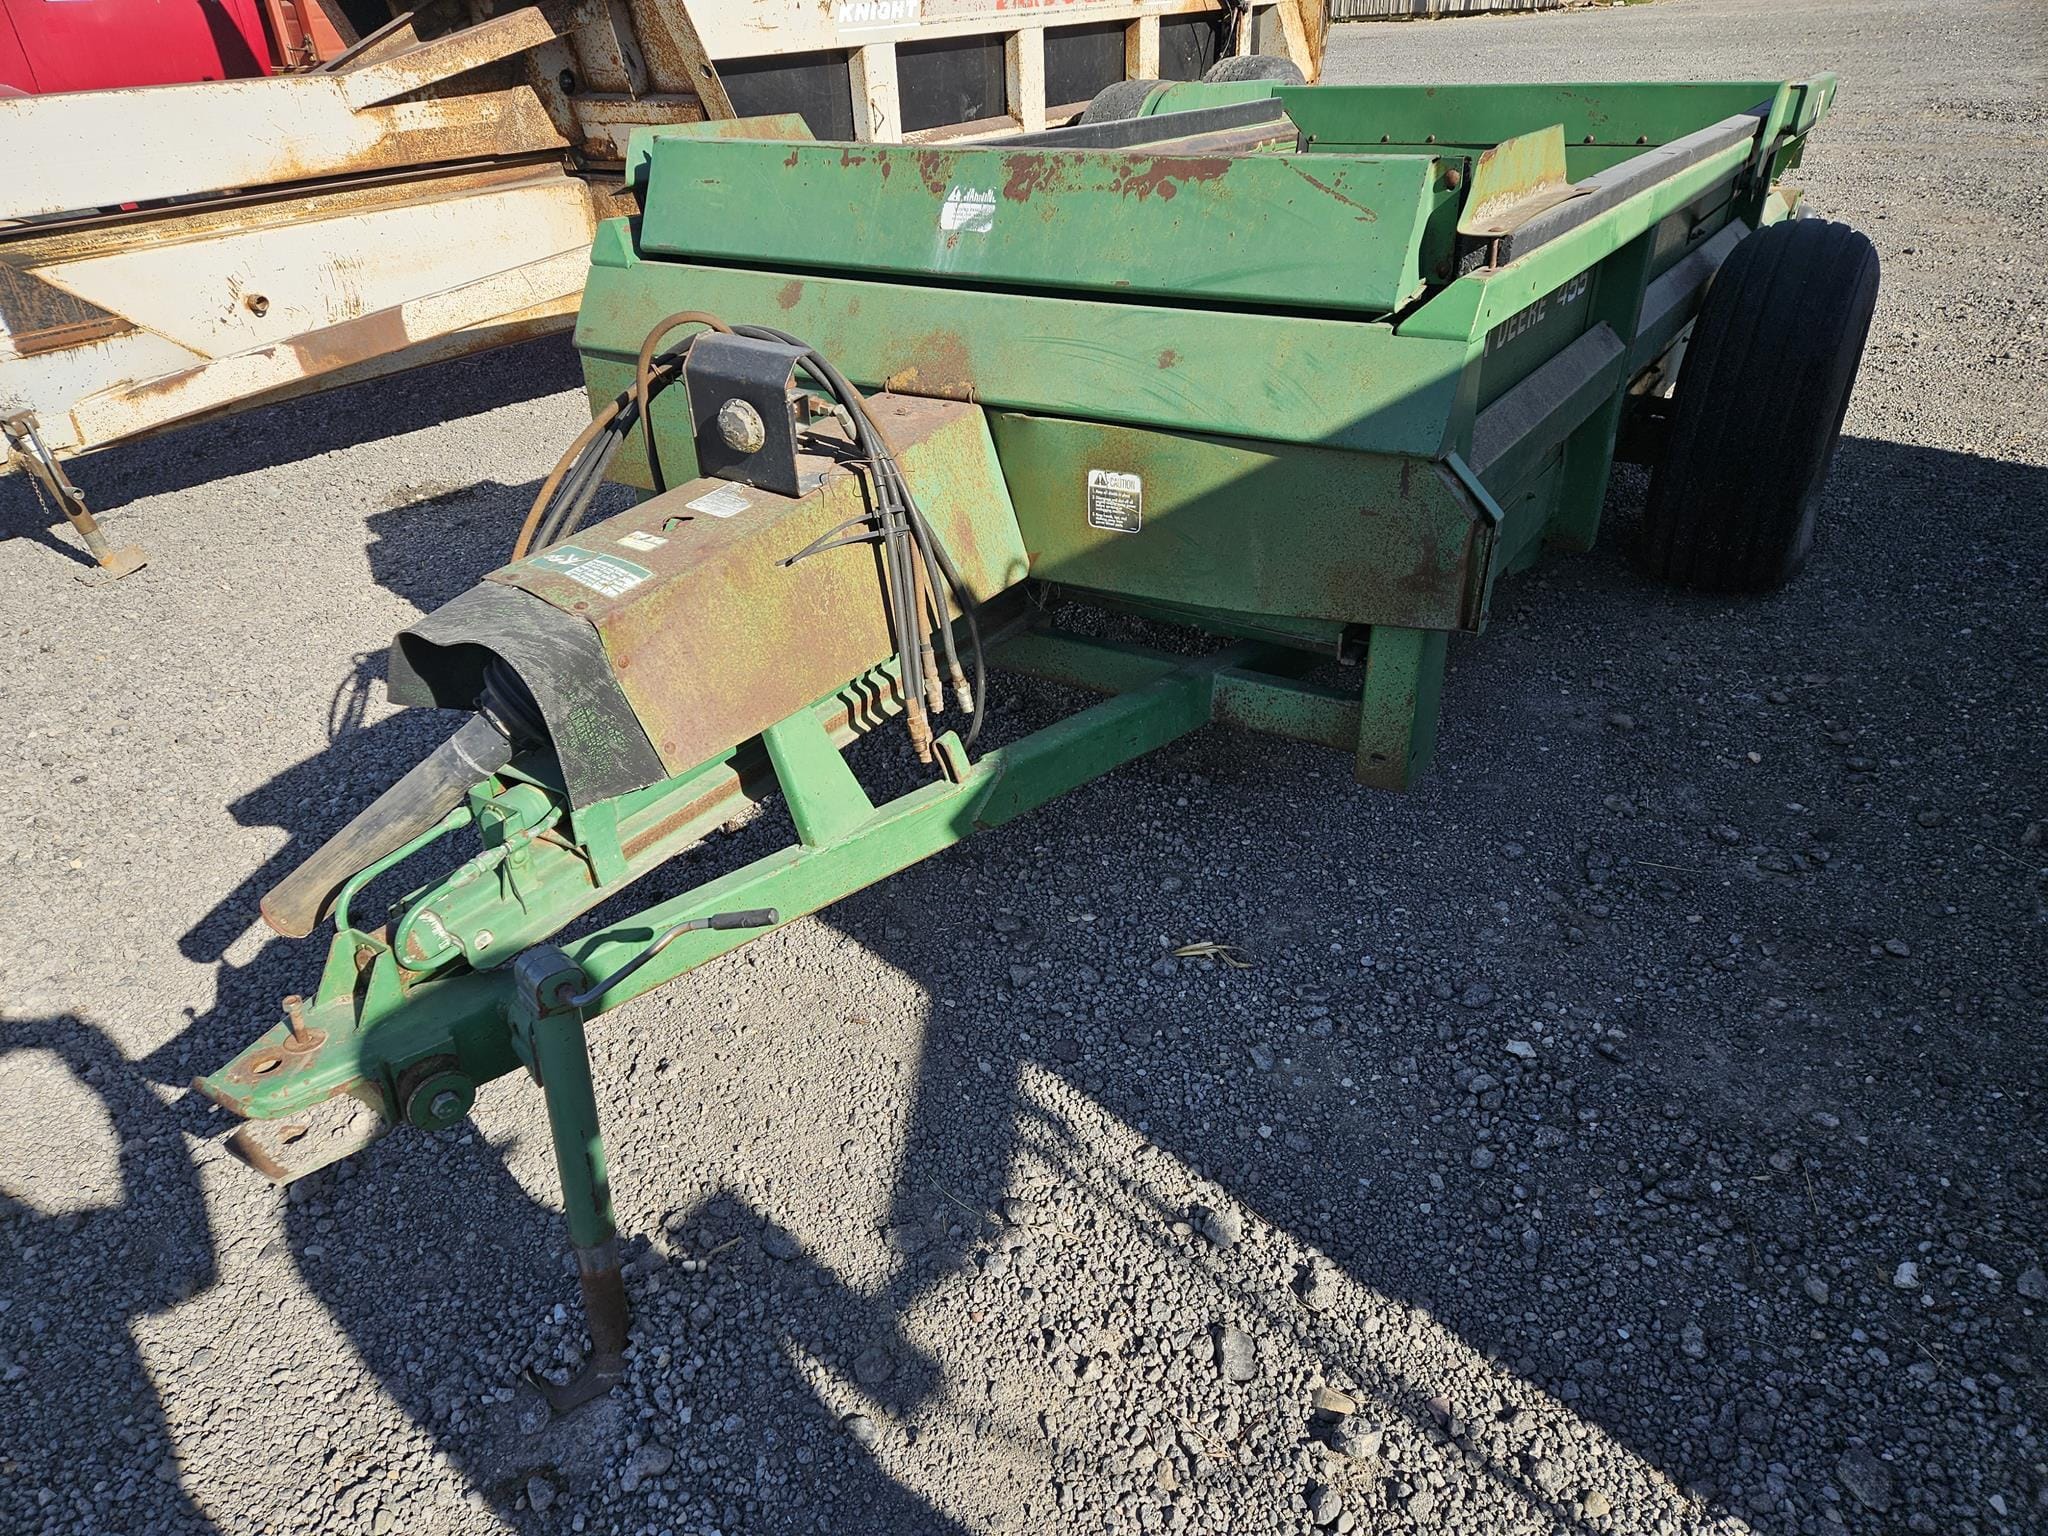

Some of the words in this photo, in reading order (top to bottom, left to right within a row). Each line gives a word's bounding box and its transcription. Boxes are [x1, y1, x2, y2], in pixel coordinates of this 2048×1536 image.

[838, 0, 918, 22] KNIGHT
[1496, 300, 1546, 349] DEERE
[1557, 272, 1588, 307] 455
[1109, 477, 1136, 491] CAUTION
